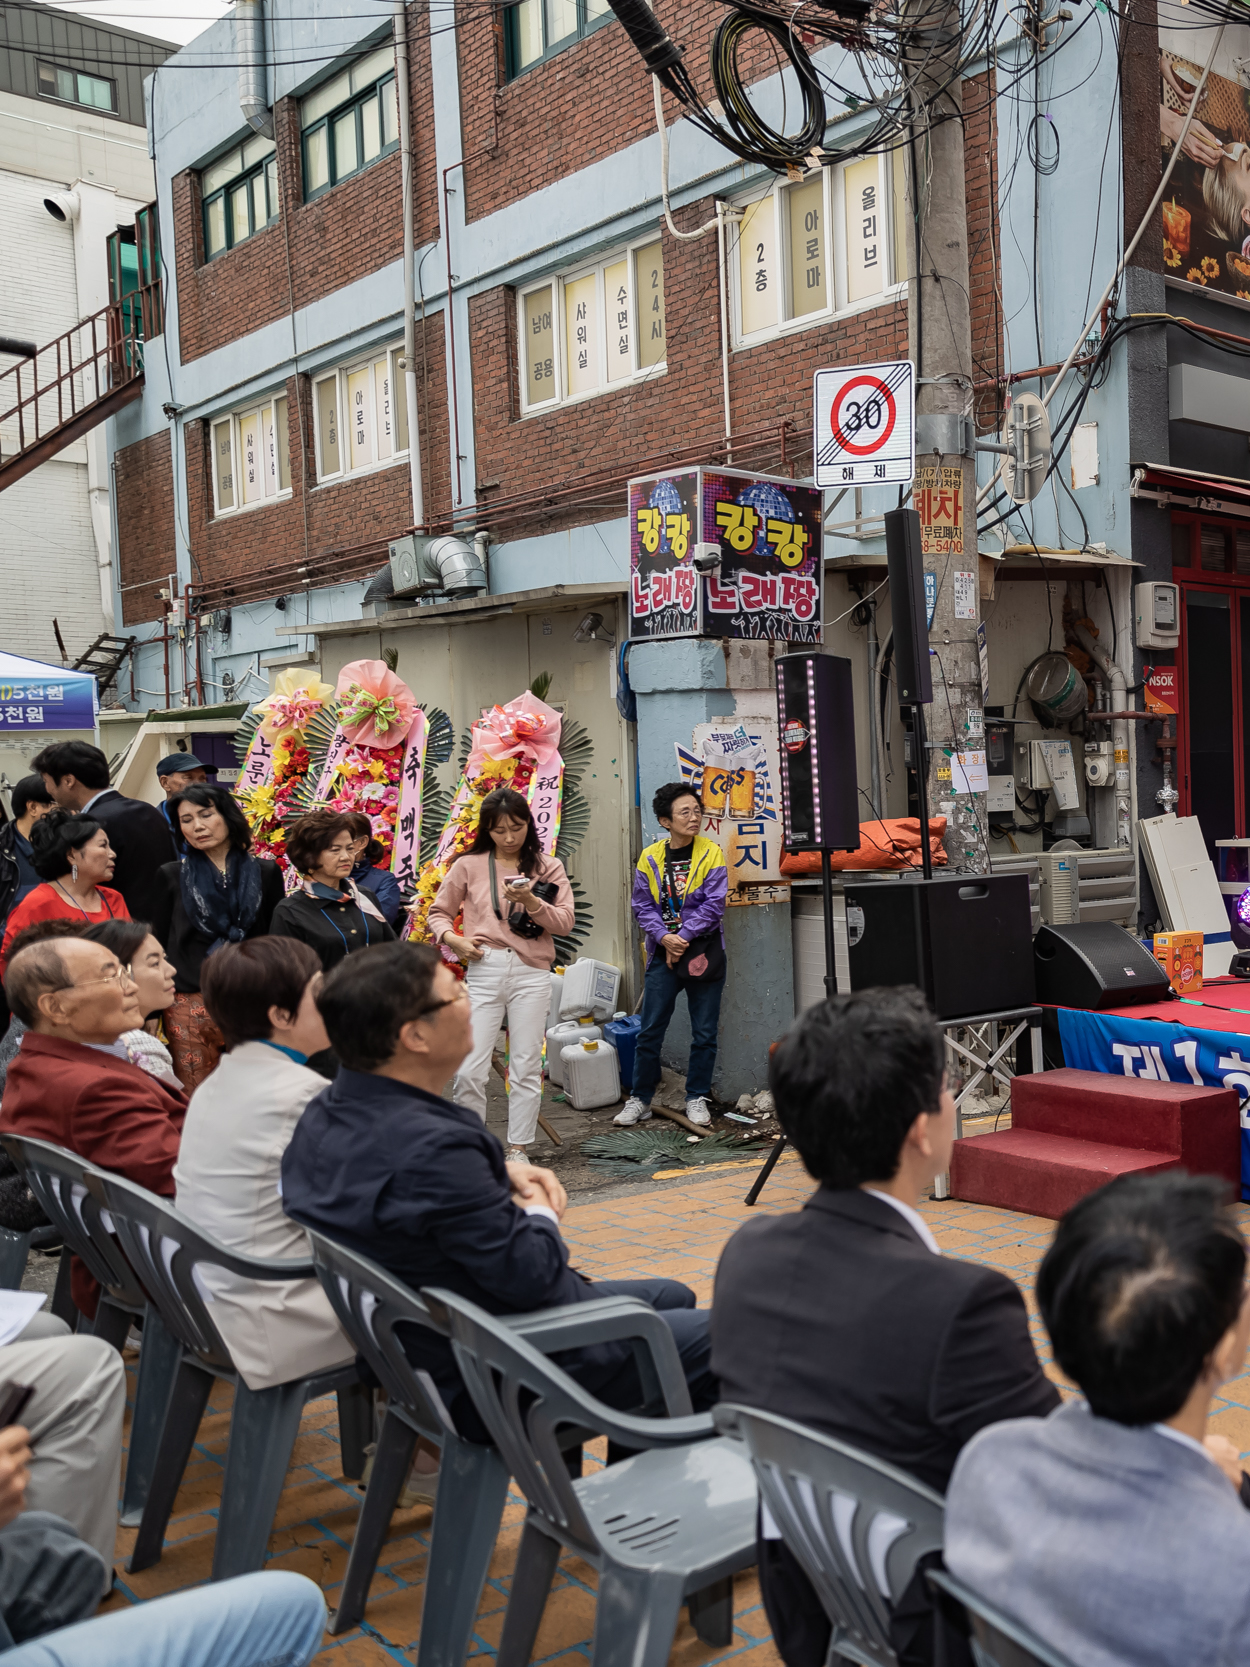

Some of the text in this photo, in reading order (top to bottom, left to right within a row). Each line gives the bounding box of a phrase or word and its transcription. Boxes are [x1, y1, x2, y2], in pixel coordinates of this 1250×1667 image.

[755, 185, 878, 292] 2층 아로마 올리브
[616, 286, 629, 355] 수면실
[651, 269, 663, 340] 24시
[532, 311, 553, 381] 남여 공용
[576, 301, 588, 369] 샤워실
[355, 389, 365, 445] 아로마
[845, 399, 882, 432] 30
[246, 432, 255, 484] 샤워실
[637, 507, 691, 560] 캉캉
[715, 501, 808, 567] 캉캉
[1149, 675, 1174, 687] NSOK
[535, 775, 560, 791] 祝
[709, 766, 746, 796] Cass
